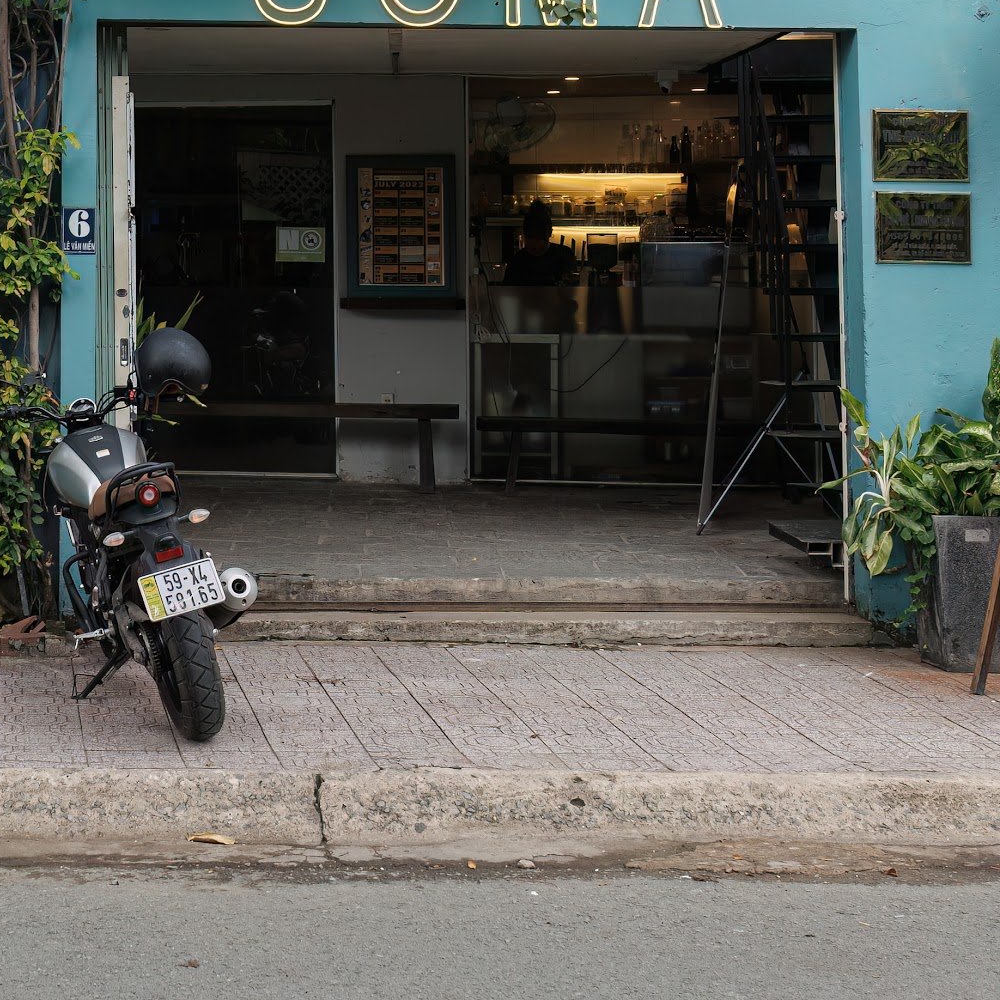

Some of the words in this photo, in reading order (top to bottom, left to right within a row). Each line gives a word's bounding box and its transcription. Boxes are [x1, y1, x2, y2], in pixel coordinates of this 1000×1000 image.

[68, 209, 90, 237] 6
[64, 241, 70, 250] LÊ
[71, 241, 82, 250] VĂN
[162, 565, 208, 592] 59-X4
